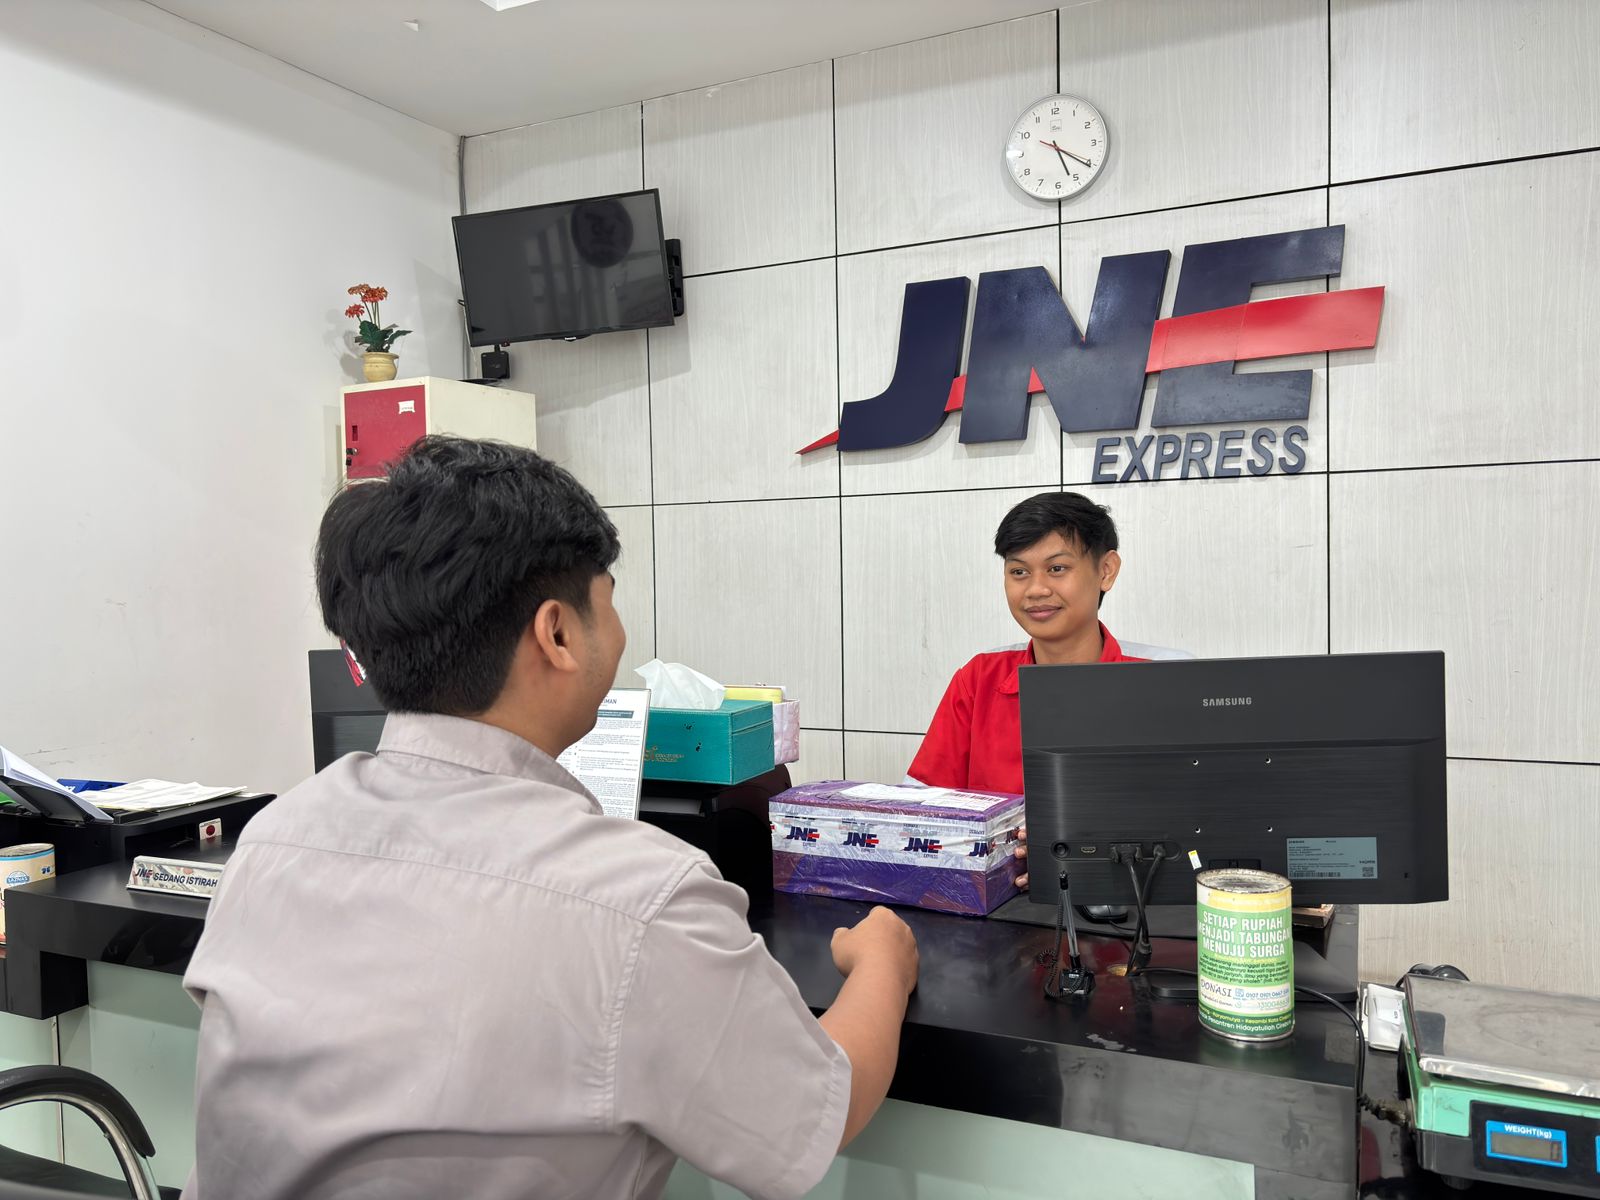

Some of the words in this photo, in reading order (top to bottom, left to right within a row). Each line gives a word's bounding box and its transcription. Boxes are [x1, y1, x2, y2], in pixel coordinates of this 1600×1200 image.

[1024, 168, 1031, 176] 8
[836, 224, 1384, 454] JNE
[1091, 425, 1309, 485] EXPRESS
[1202, 697, 1252, 706] SAMSUNG
[786, 826, 820, 842] JNE
[842, 832, 879, 848] JNE
[903, 837, 943, 853] JNE
[135, 868, 153, 878] JNE
[154, 873, 185, 884] SEDANG
[1203, 911, 1237, 929] SETIAP
[1242, 916, 1283, 931] RUPIAH
[1203, 937, 1245, 957] MENUJU
[1250, 943, 1285, 958] SURGA
[1504, 1124, 1552, 1139] WEIGHT(kg)
